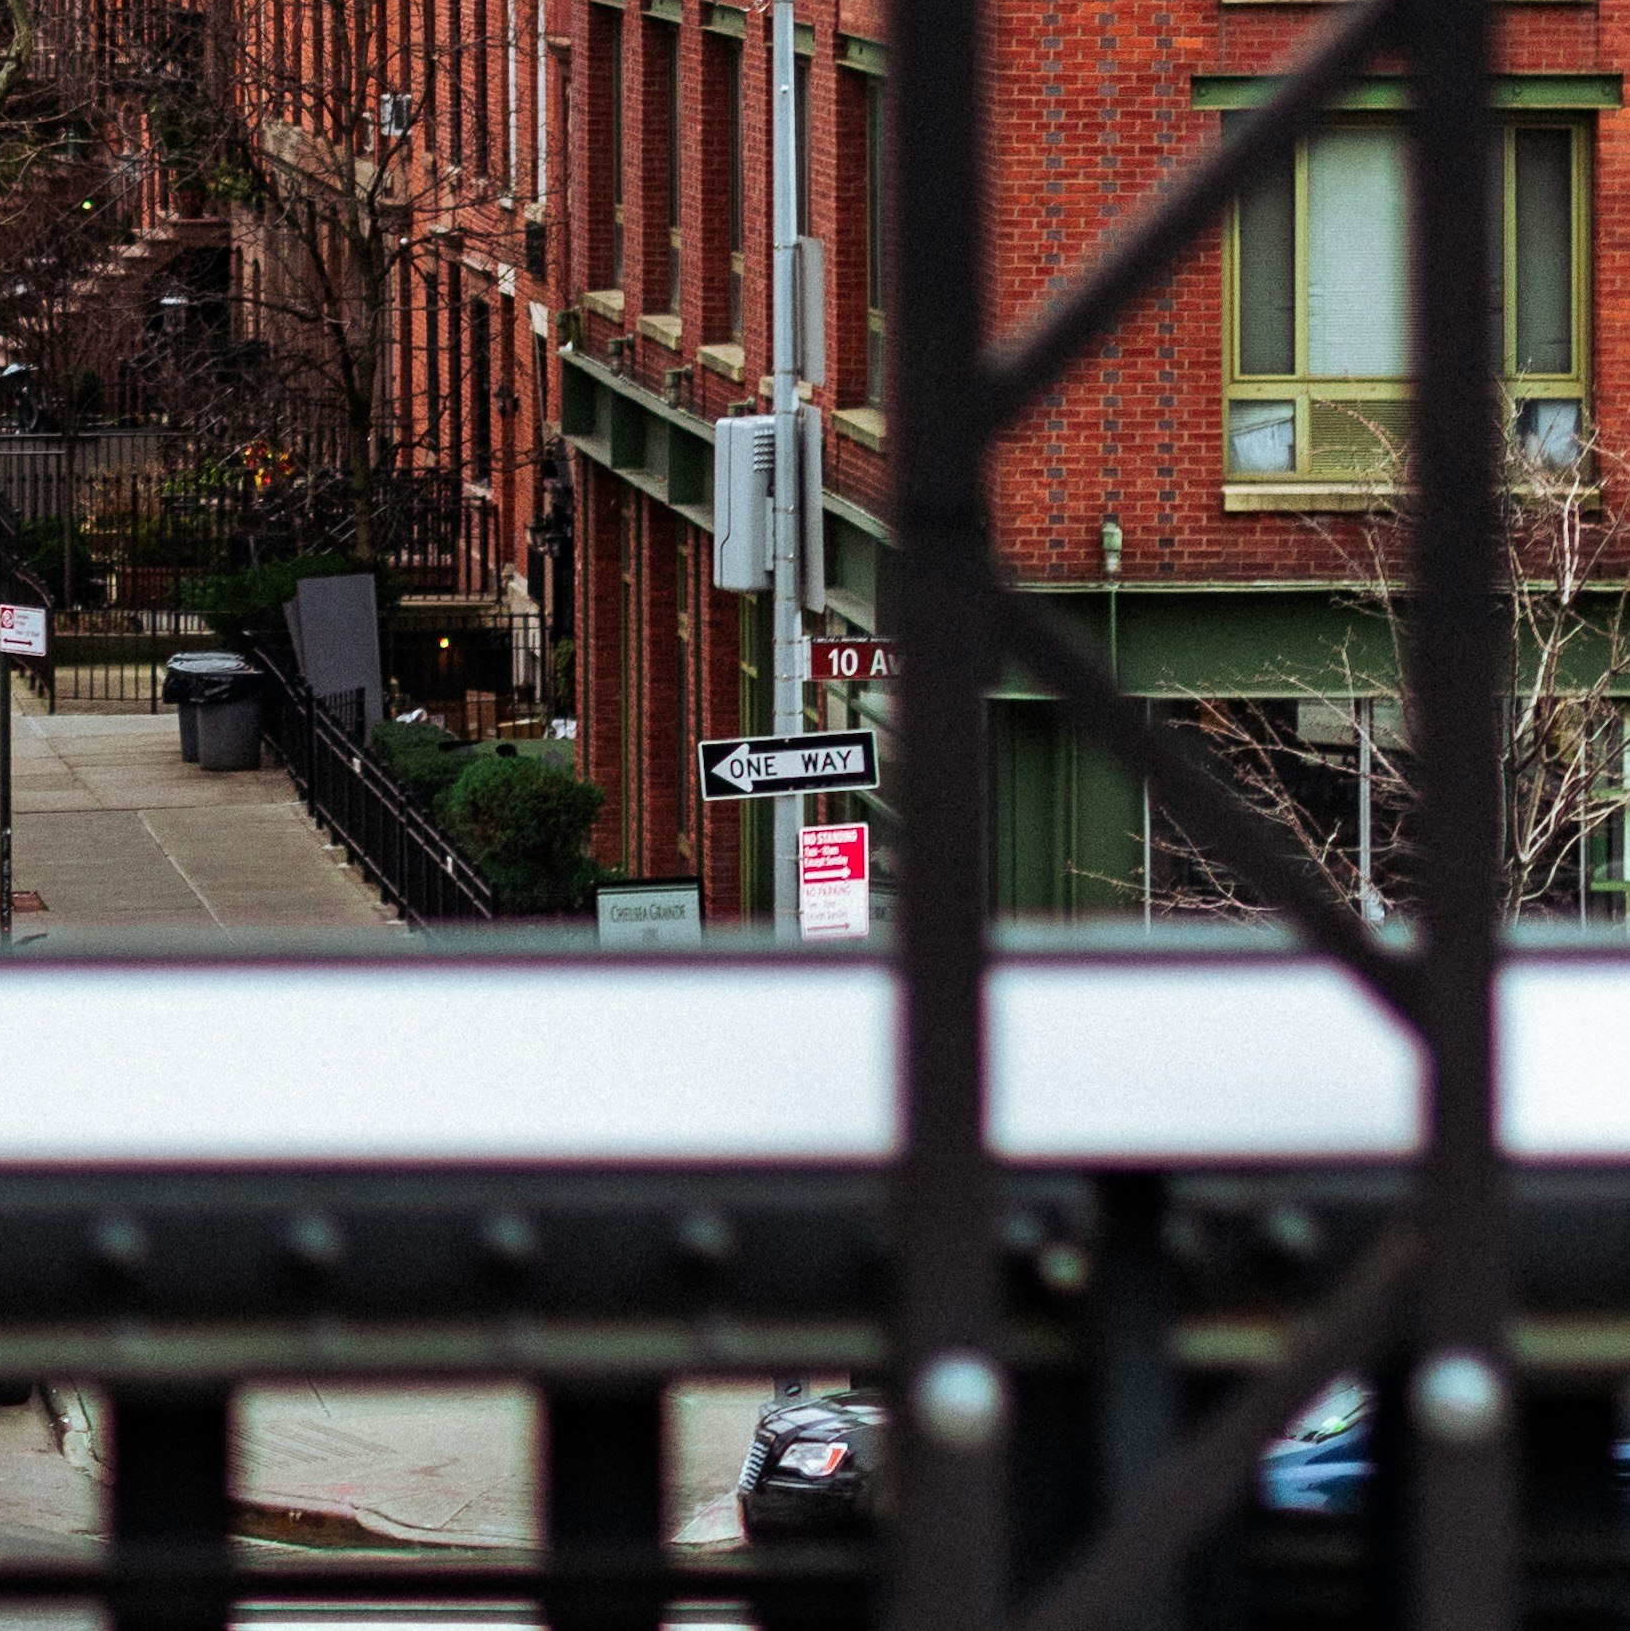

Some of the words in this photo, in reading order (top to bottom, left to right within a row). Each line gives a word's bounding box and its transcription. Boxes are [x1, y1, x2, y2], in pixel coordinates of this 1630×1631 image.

[827, 647, 859, 677] 10
[729, 755, 777, 779] ONE
[801, 749, 853, 773] WAY
[804, 833, 816, 845] NO
[817, 830, 857, 845] STANDING
